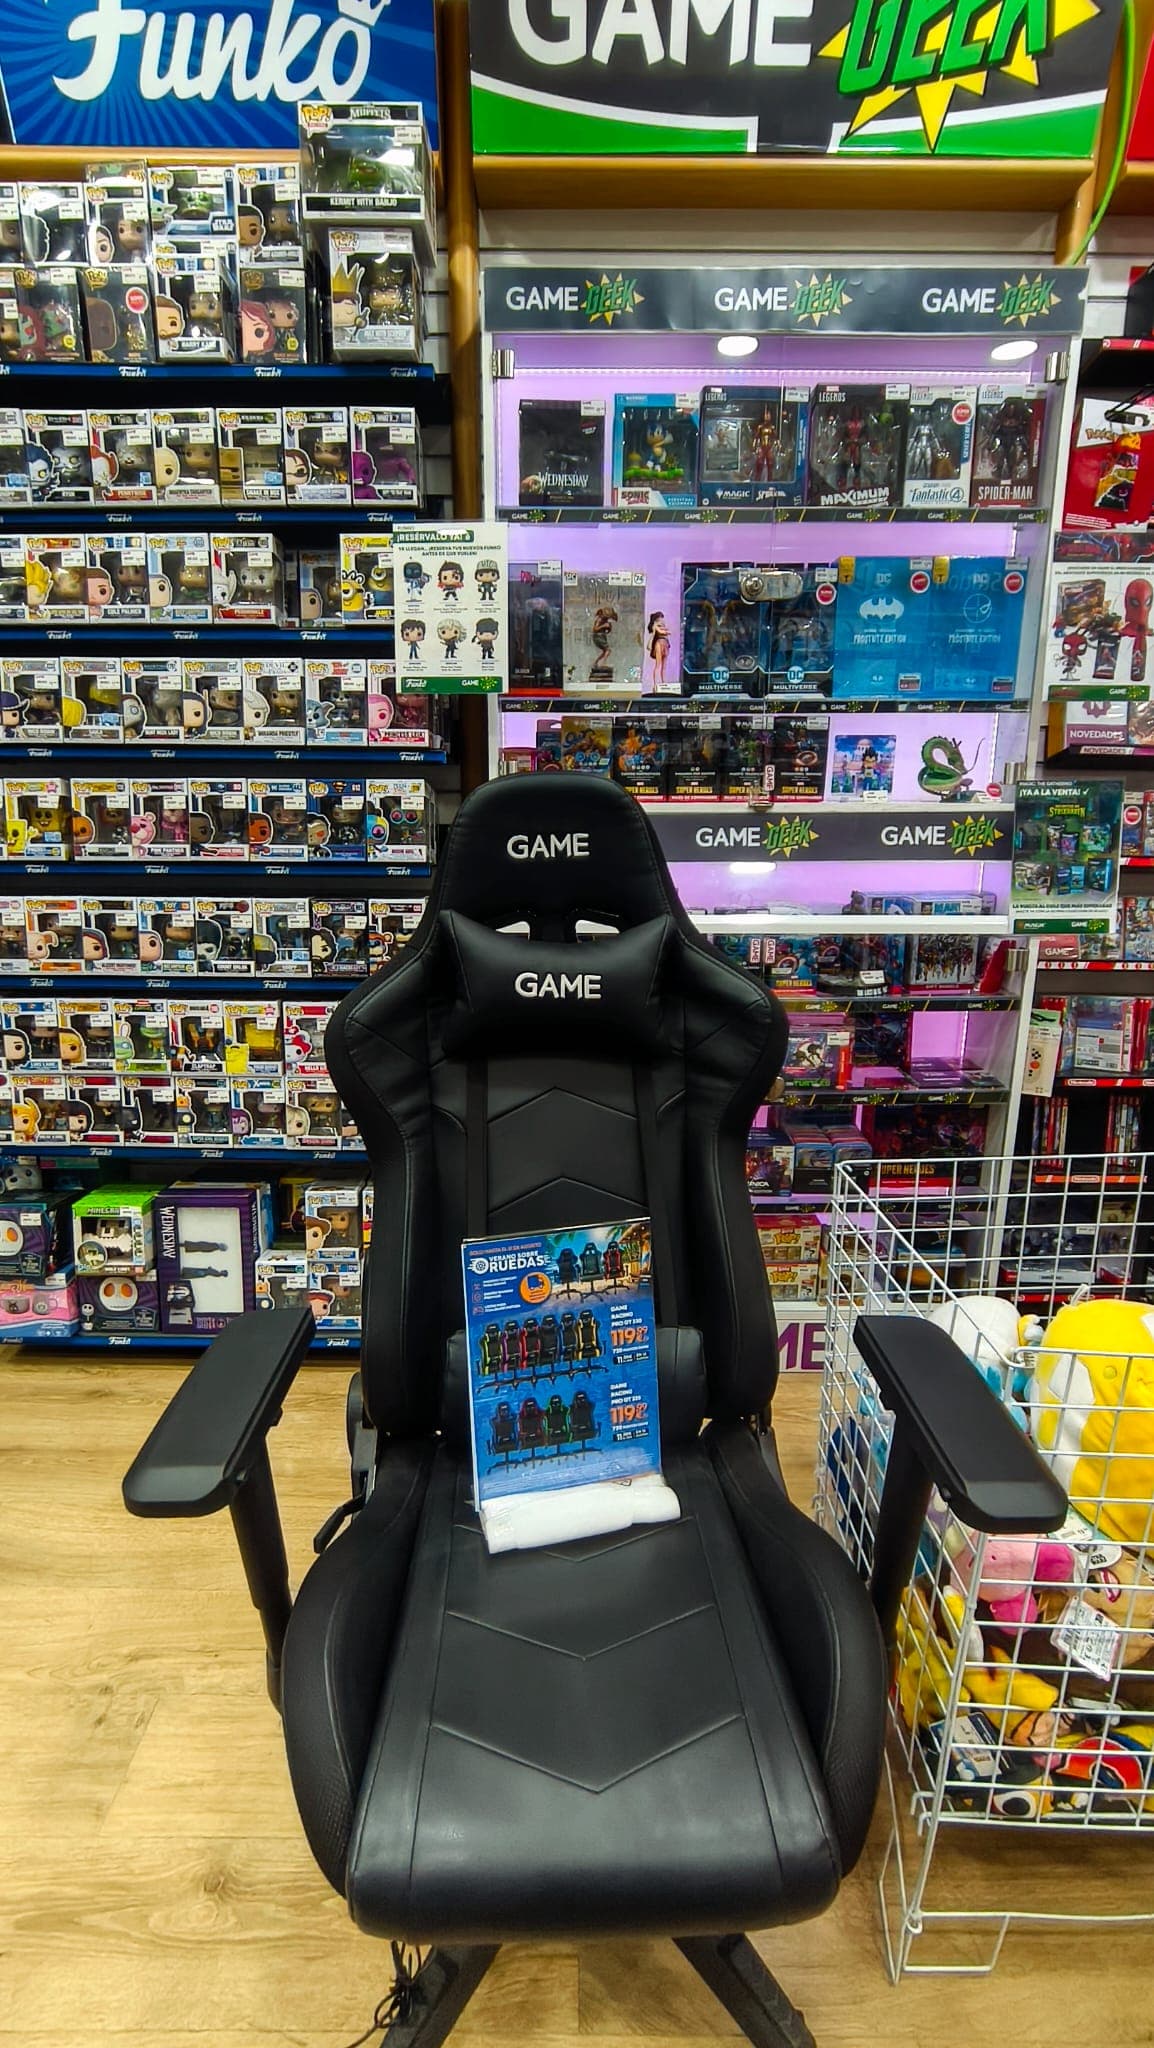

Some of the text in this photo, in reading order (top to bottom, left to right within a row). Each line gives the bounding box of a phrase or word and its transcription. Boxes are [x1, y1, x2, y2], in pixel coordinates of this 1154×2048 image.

[52, 0, 372, 101] Funko
[508, 0, 1048, 94] GAME GEEK
[330, 197, 354, 206] KERMIT
[356, 198, 371, 207] WITH
[506, 279, 638, 313] GAME GEEK
[715, 279, 847, 315] GAME GEEK
[923, 280, 1058, 318] GAME GEEK
[819, 392, 846, 401] LEGENDS
[538, 471, 588, 487] WEDNESDAY
[820, 487, 889, 506] MAXIMUM
[978, 486, 1033, 500] SPIDER-MAN
[766, 767, 774, 789] GAME
[1041, 788, 1051, 796] LA
[1052, 788, 1080, 796] VENTA!
[507, 833, 590, 858] GAME
[696, 820, 813, 849] GAME GEEK
[882, 819, 998, 850] GAME GEEK
[752, 939, 760, 962] GAME
[766, 939, 775, 962] GAME
[515, 972, 602, 999] GAME
[160, 1206, 175, 1258] WEDNESDAY
[490, 1255, 545, 1273] RUEDAS
